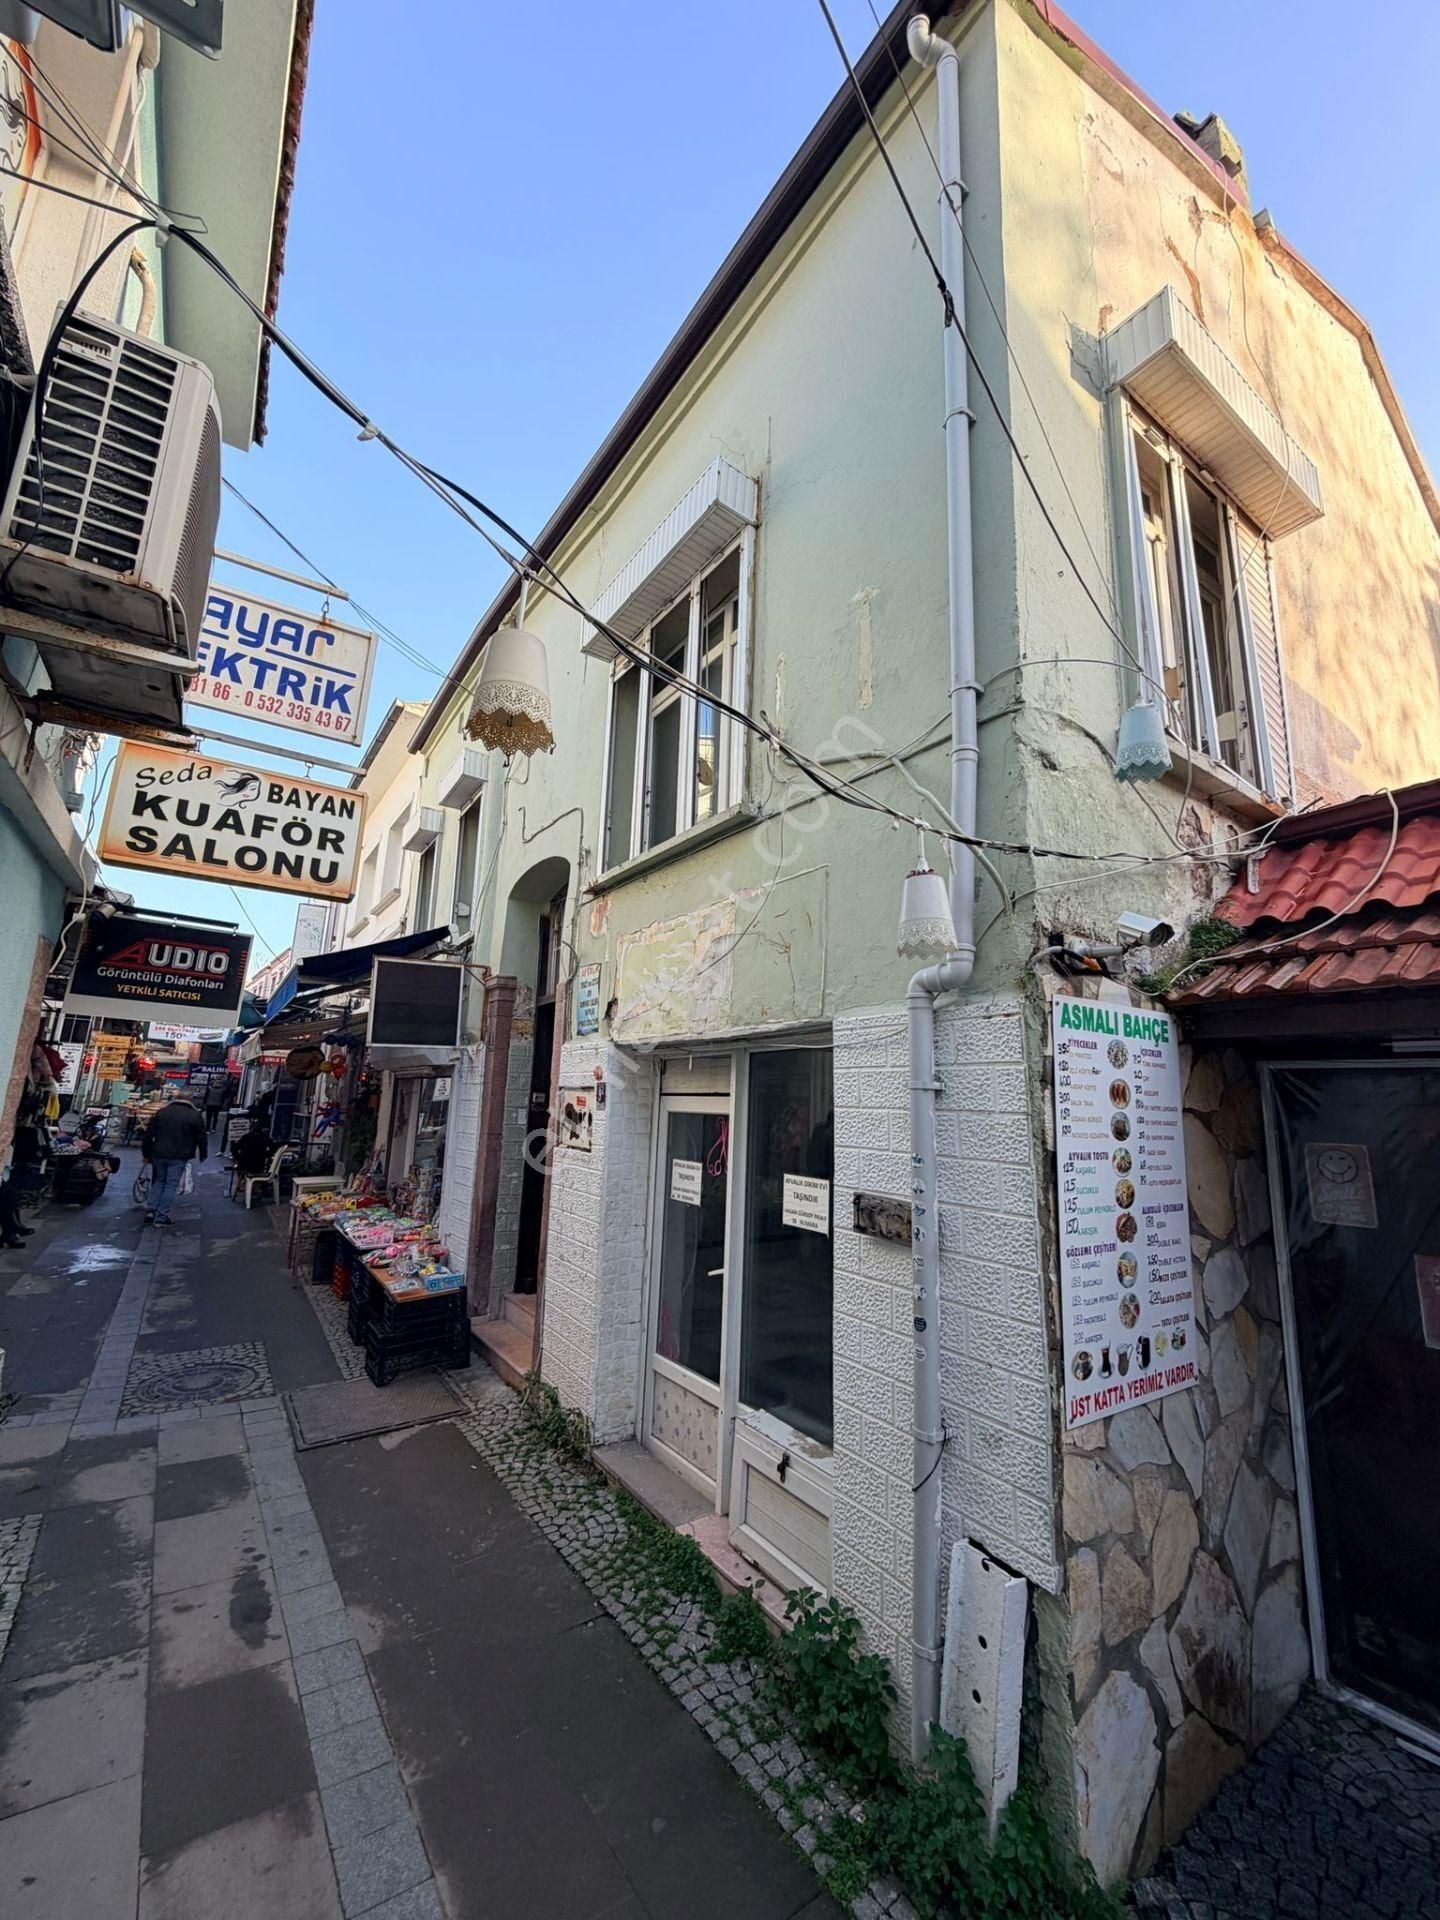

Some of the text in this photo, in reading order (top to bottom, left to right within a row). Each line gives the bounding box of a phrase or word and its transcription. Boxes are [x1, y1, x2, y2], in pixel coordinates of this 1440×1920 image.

[212, 681, 232, 700] 86
[244, 690, 254, 707] 0
[257, 694, 284, 714] 532
[287, 702, 312, 722] 335
[315, 711, 332, 728] 43
[335, 716, 351, 732] 67
[135, 762, 212, 788] Seda
[267, 783, 355, 819] BAYAN
[132, 790, 346, 854] KUAFÖR
[125, 826, 339, 884] SALONU
[102, 942, 230, 974] AUDIO
[97, 966, 224, 990] Görüntülü Diafonları
[116, 983, 201, 1001] YETKİLİ SATICISI
[1060, 1002, 1170, 1048] ASMALI BAHÇE
[1068, 1151, 1110, 1161] AYVALIK TOSTU
[793, 1191, 819, 1203] TAŞINDIK
[1064, 1178, 1077, 1193] 125
[1064, 1196, 1078, 1213] 125
[1066, 1244, 1092, 1258] GÖZLEME
[1070, 1362, 1196, 1420] ÜST KATTA YERİMİZ VARDIR
